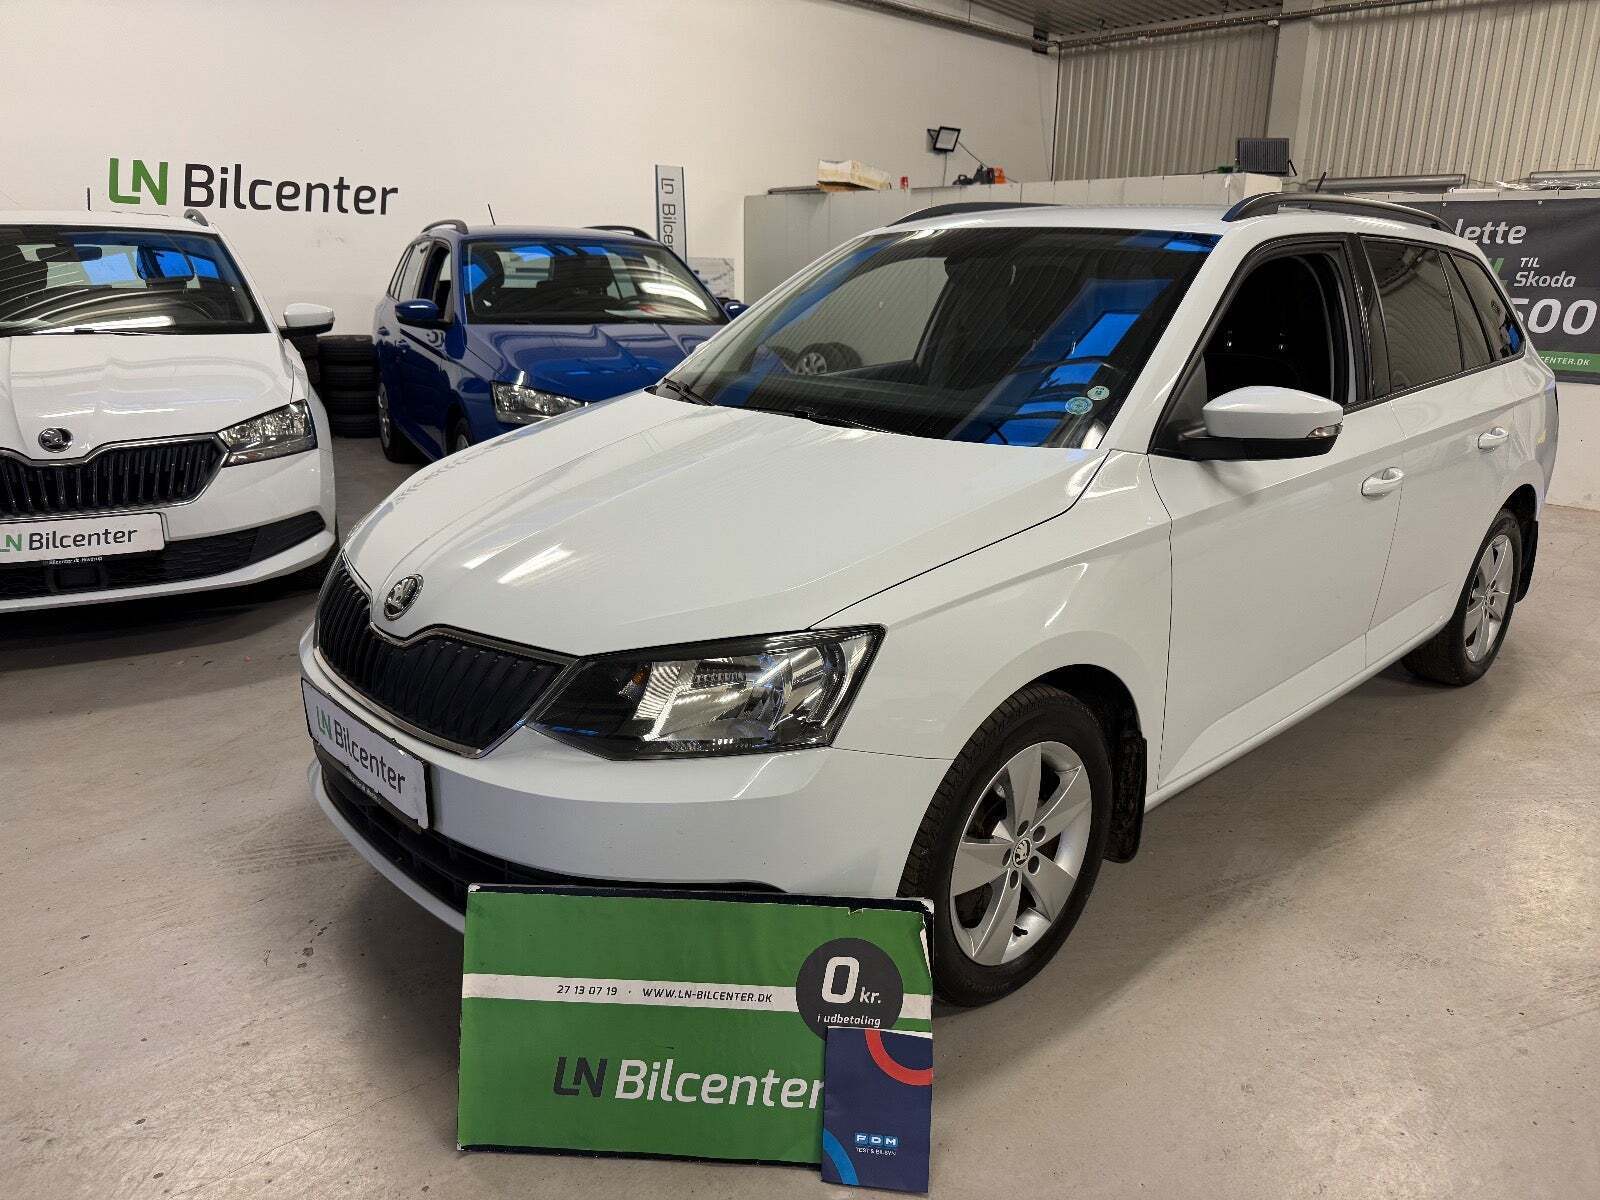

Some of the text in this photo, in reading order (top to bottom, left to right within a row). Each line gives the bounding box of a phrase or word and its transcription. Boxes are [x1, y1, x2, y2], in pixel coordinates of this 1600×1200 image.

[109, 158, 398, 215] LN Bilcenter
[1520, 257, 1540, 268] TIL
[1514, 271, 1576, 288] Skoda
[1541, 356, 1590, 366] ENTER.DK
[29, 528, 138, 550] Bilcenter
[316, 705, 332, 740] LN
[334, 719, 406, 794] Bilcenter
[822, 956, 881, 1004] 0 kr.
[557, 985, 772, 1003] 27 13 07 19 WWW.LN-BILCENTER.DK
[816, 1013, 880, 1028] i udbetaling
[553, 1056, 824, 1109] LN Bilcenter
[856, 1134, 897, 1146] FDM
